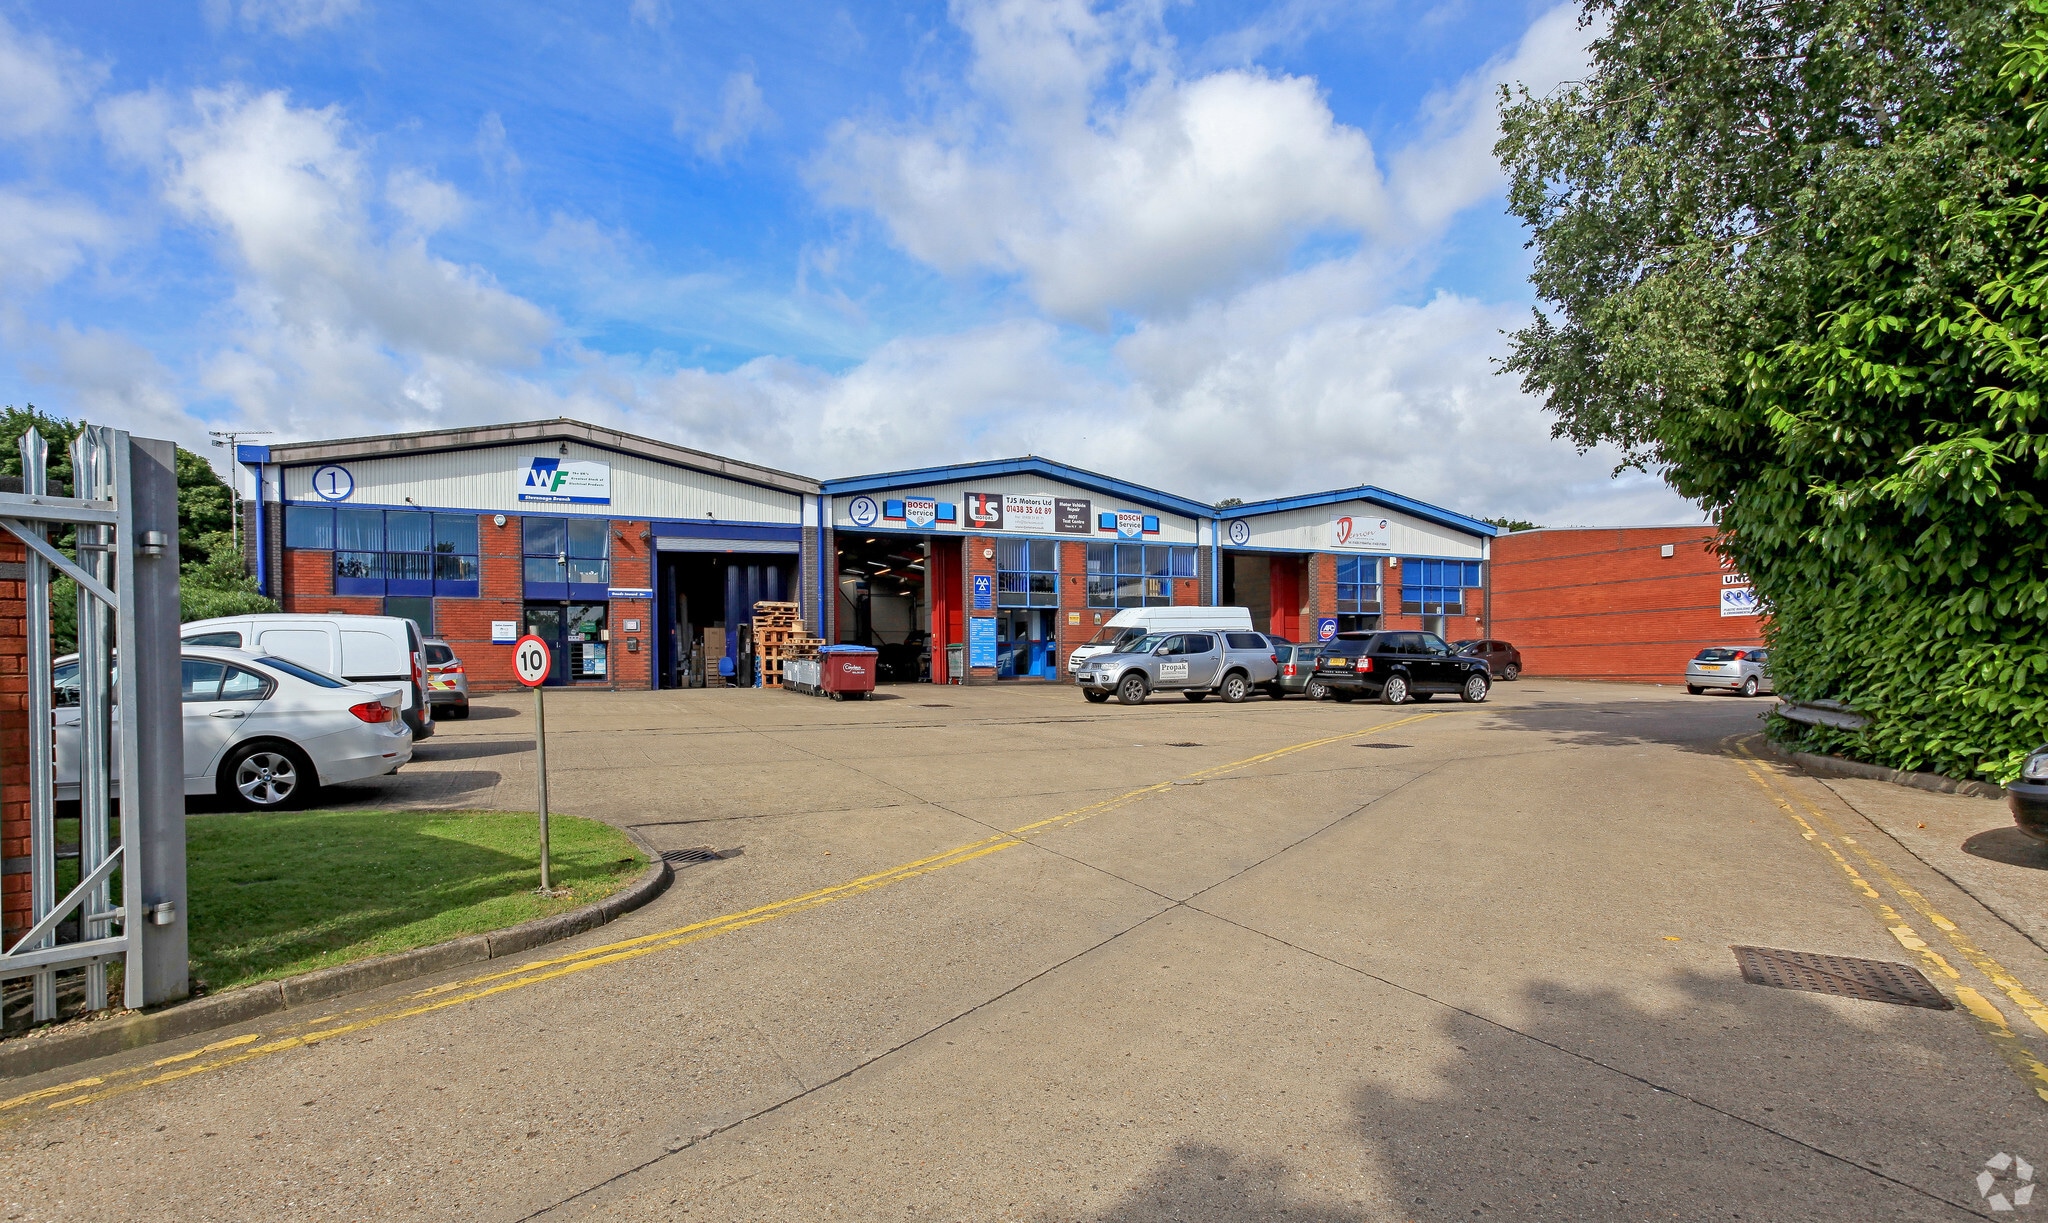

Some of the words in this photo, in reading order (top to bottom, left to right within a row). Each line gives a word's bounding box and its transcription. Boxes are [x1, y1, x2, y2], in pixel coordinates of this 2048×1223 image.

[327, 471, 341, 494] 1
[529, 469, 569, 492] WF
[858, 501, 869, 520] 2
[1235, 523, 1244, 541] 3
[520, 650, 542, 671] 10
